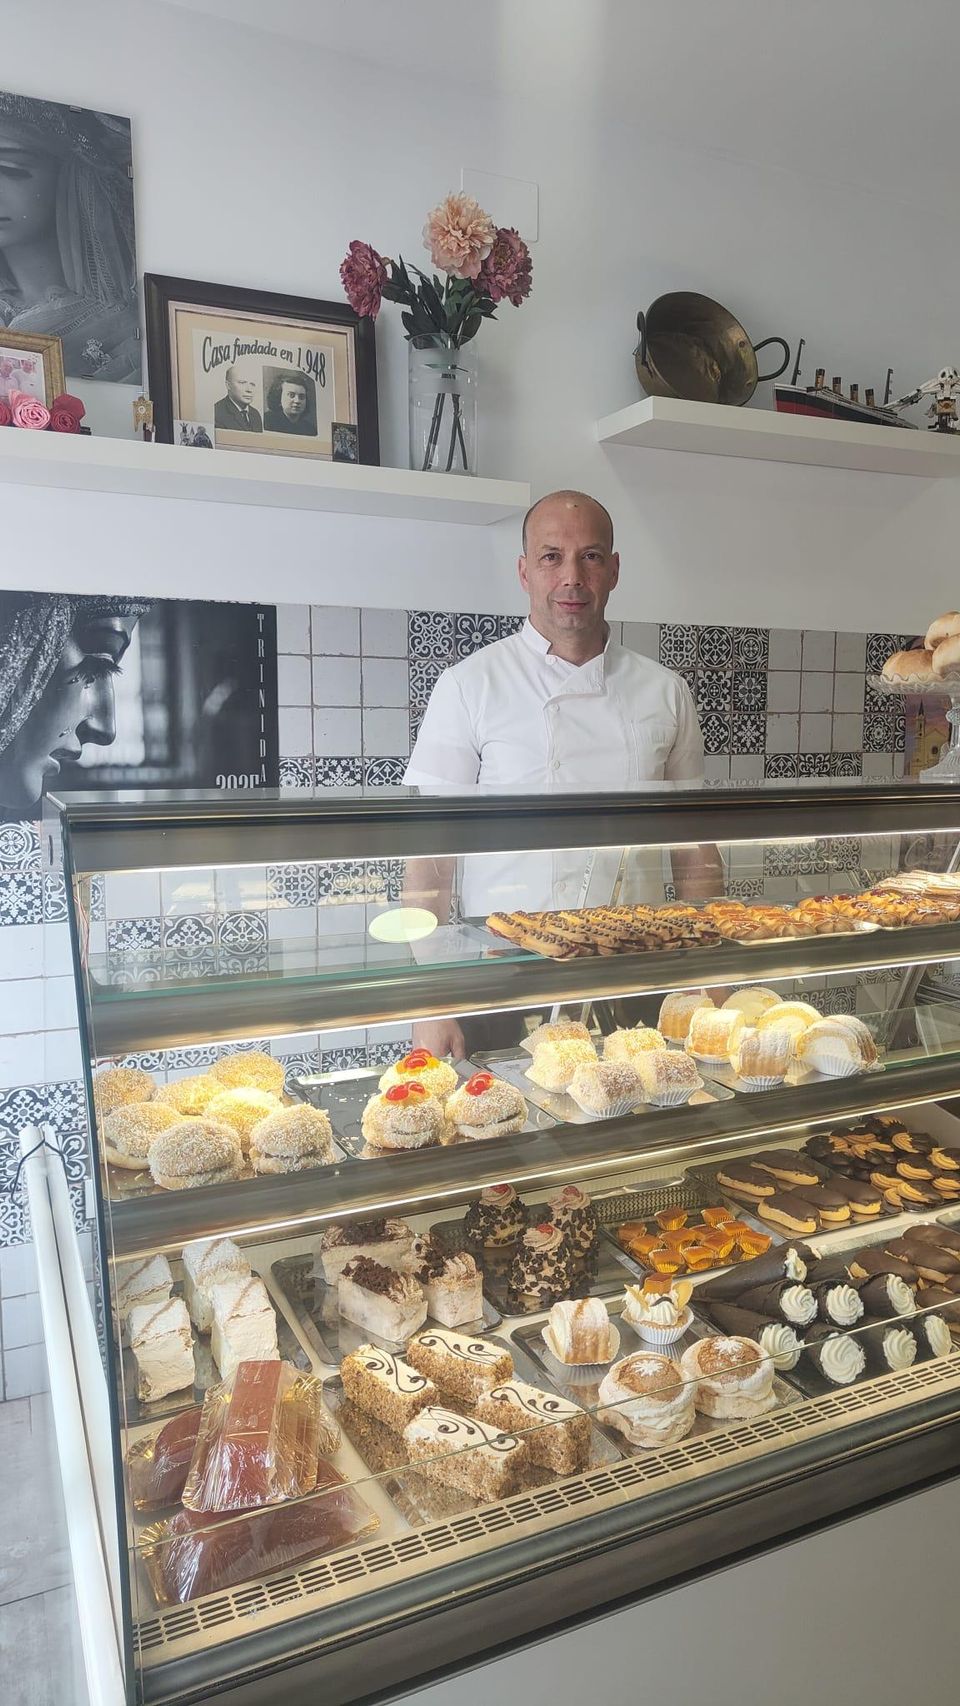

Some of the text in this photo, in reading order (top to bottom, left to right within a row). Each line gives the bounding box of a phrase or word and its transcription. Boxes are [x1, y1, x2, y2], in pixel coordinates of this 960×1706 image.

[202, 336, 327, 388] Casa fundada en 1.948
